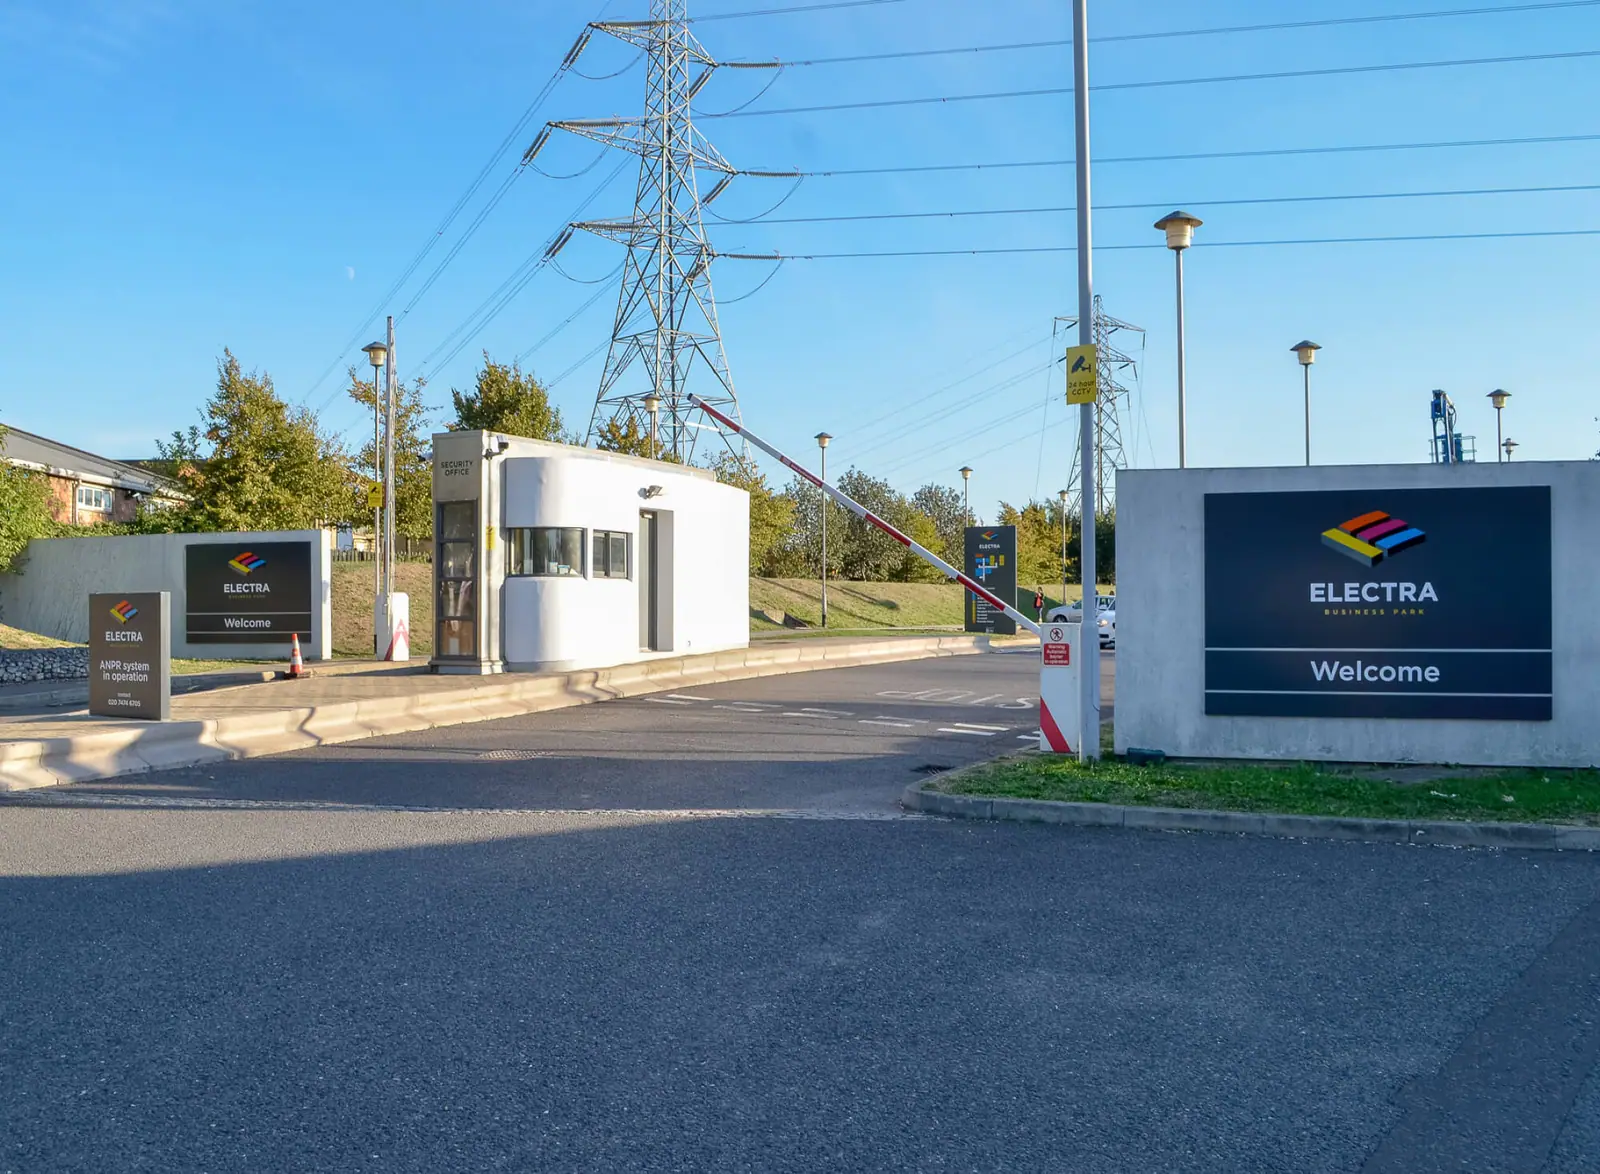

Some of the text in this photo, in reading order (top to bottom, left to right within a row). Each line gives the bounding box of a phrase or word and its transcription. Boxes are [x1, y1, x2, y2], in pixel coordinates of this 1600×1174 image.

[1072, 388, 1091, 396] CCTV
[441, 460, 473, 469] SECURITY
[445, 468, 470, 476] OFFICE
[223, 583, 270, 593] ELECTRA
[1310, 582, 1439, 602] ELECTRA
[224, 618, 271, 628] Welcome
[105, 631, 143, 642] ELECTRA
[100, 661, 150, 672] ANPR system
[1310, 660, 1440, 682] Welcome
[103, 671, 148, 682] in operation
